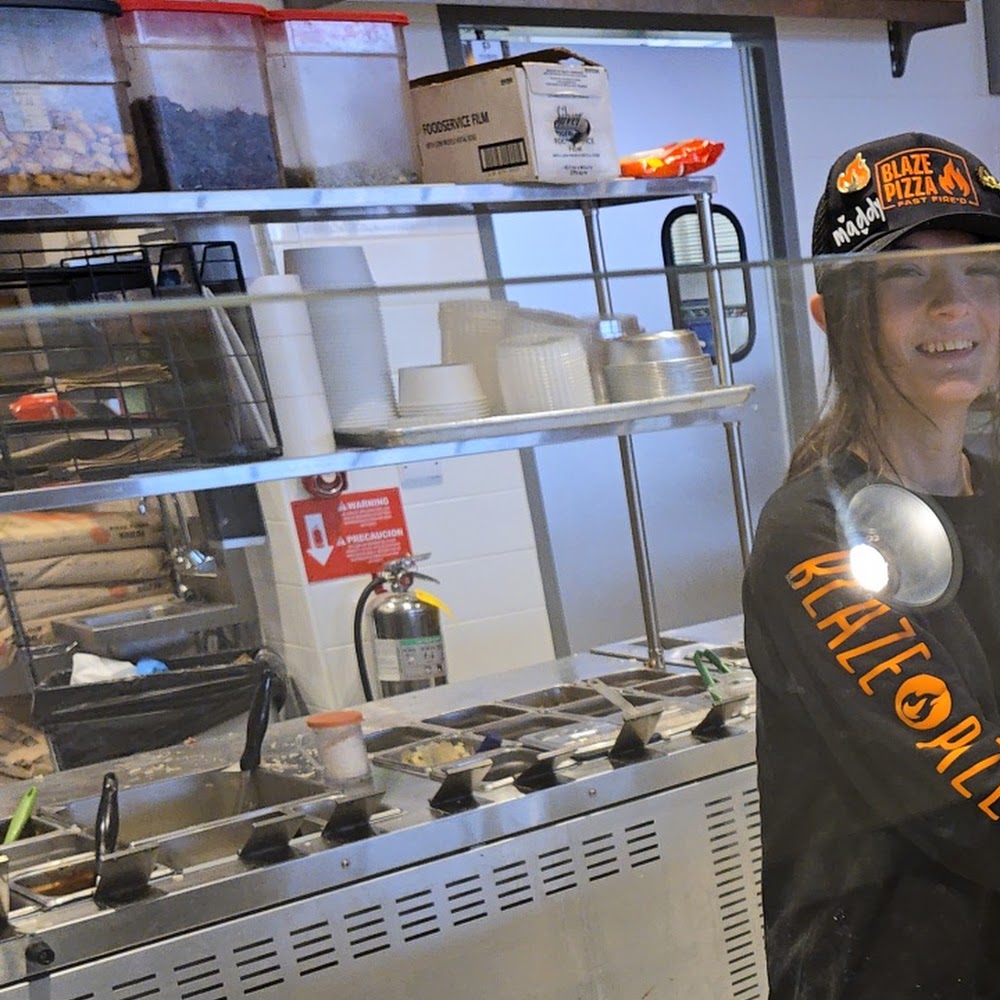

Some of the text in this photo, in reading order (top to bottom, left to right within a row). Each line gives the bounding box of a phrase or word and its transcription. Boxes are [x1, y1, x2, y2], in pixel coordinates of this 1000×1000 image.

[422, 111, 490, 135] FOODSERVICE FILM
[880, 153, 934, 183] BLAZE
[884, 177, 938, 203] PIZZA
[897, 196, 927, 208] FAST
[832, 197, 886, 247] maddy
[348, 497, 389, 510] WARNING
[785, 550, 932, 696] BLAZE
